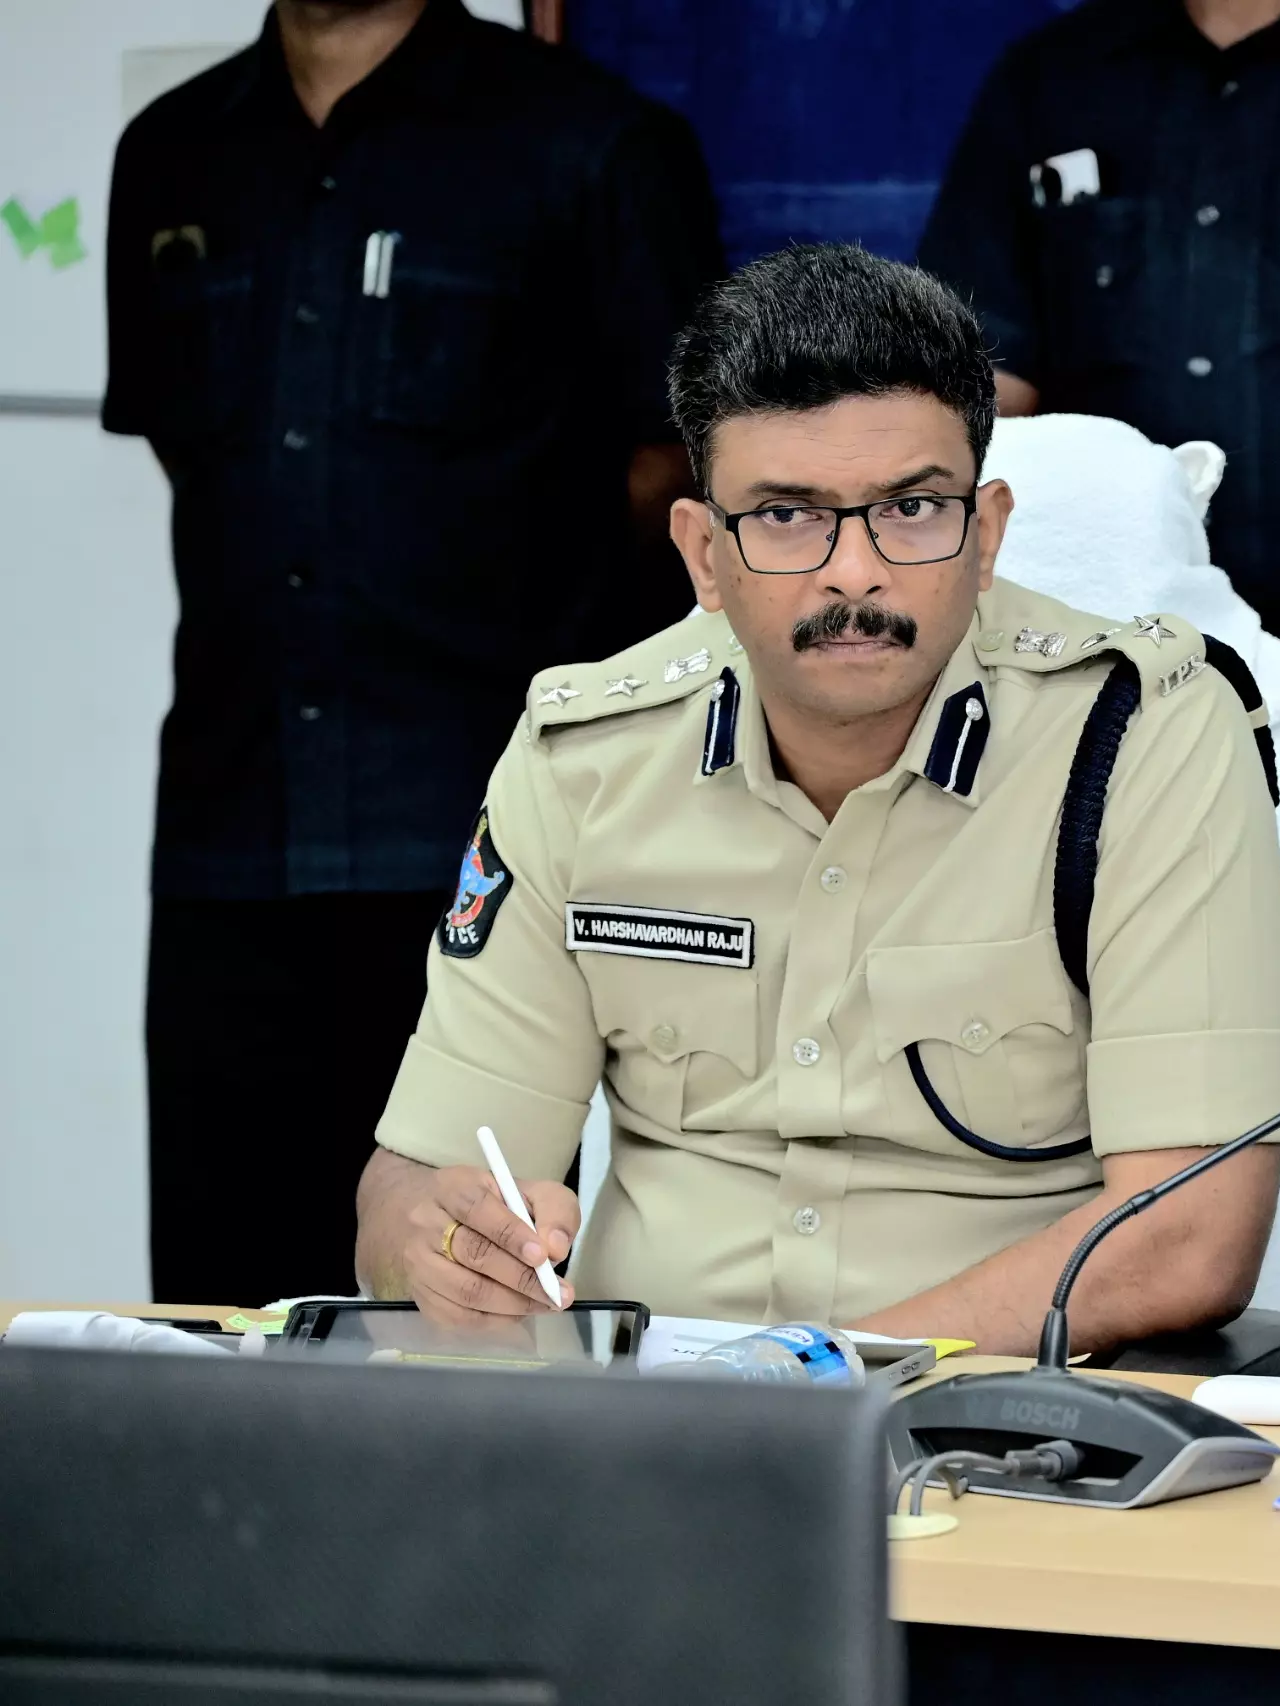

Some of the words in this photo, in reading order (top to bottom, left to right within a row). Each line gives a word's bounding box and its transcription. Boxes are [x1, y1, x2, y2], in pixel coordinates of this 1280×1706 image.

[1159, 653, 1206, 697] IPS
[575, 919, 589, 936] V.
[591, 920, 704, 947] HARSHAVARDHAN
[707, 931, 743, 951] RAJU
[1000, 1396, 1081, 1431] BOSCH
